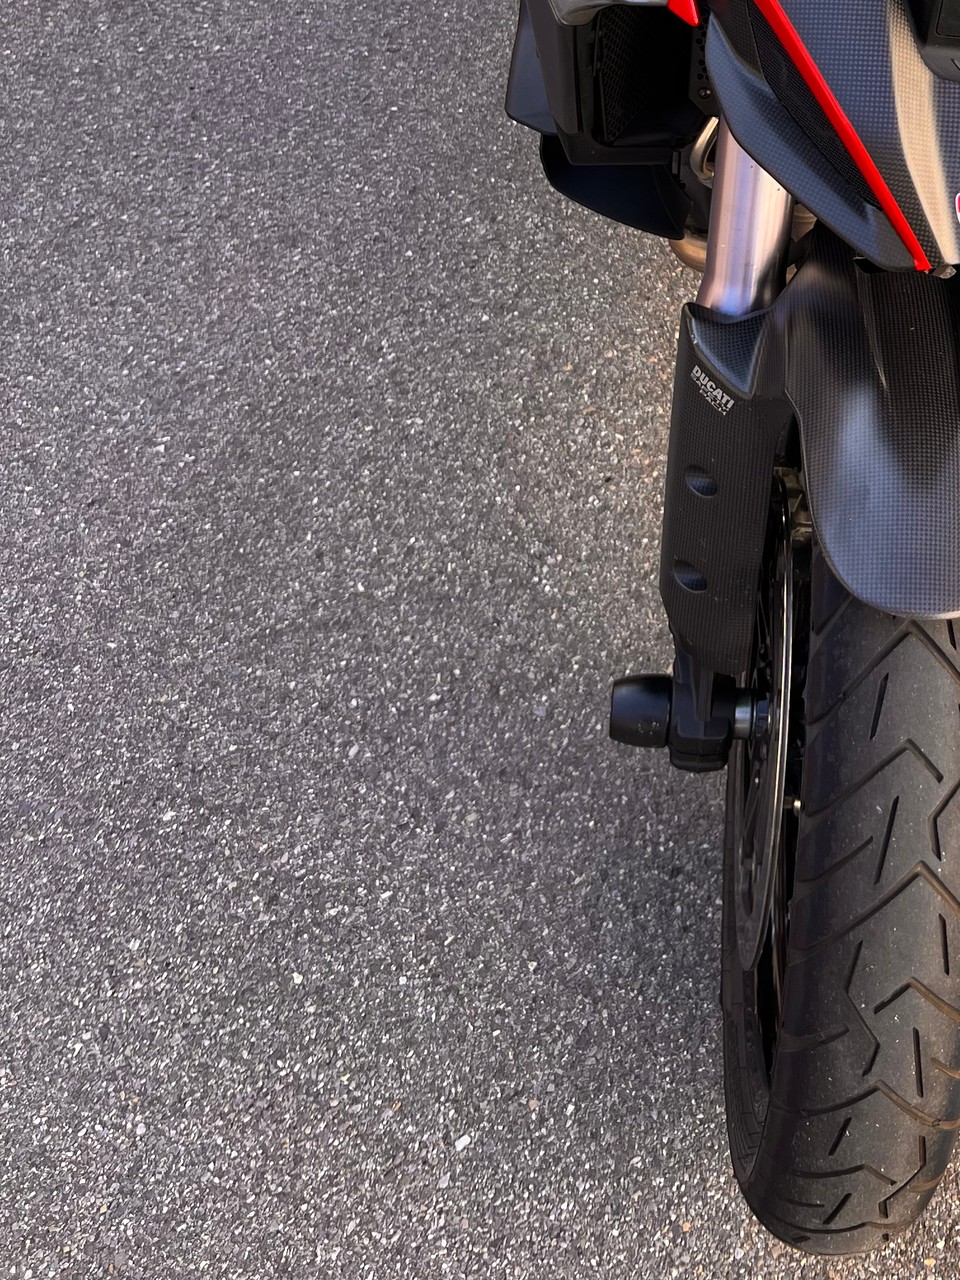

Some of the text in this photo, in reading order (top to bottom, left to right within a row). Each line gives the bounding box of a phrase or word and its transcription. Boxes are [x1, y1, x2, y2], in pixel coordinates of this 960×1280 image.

[690, 372, 730, 411] SAFETY
[692, 365, 735, 409] DUCATI
[699, 389, 727, 416] PACK
